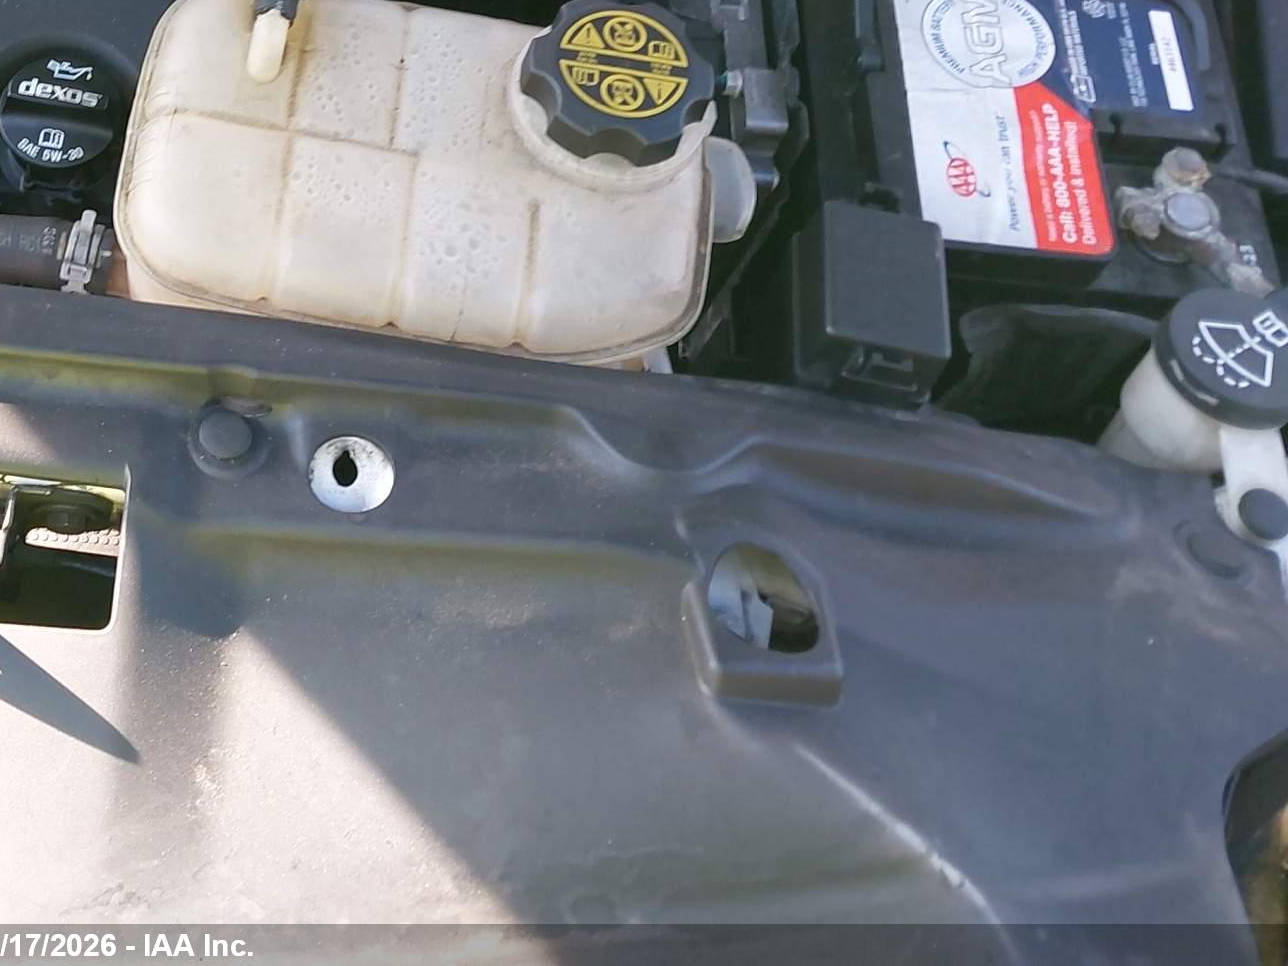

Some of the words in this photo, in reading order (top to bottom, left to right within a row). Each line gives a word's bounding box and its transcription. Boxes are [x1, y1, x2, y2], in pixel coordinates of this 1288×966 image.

[930, 32, 964, 74] PREMIUM
[18, 78, 101, 108] dexos
[995, 114, 1008, 141] trust
[17, 138, 41, 159] SAE
[42, 146, 84, 162] 5W-30
[1001, 147, 1012, 164] can
[1042, 103, 1071, 207] 800-AAA-HELP
[949, 157, 976, 196] AAA
[1073, 178, 1085, 187] &
[1007, 194, 1020, 232] Power
[1058, 212, 1078, 243] Call:
[1076, 190, 1097, 245] Delivered
